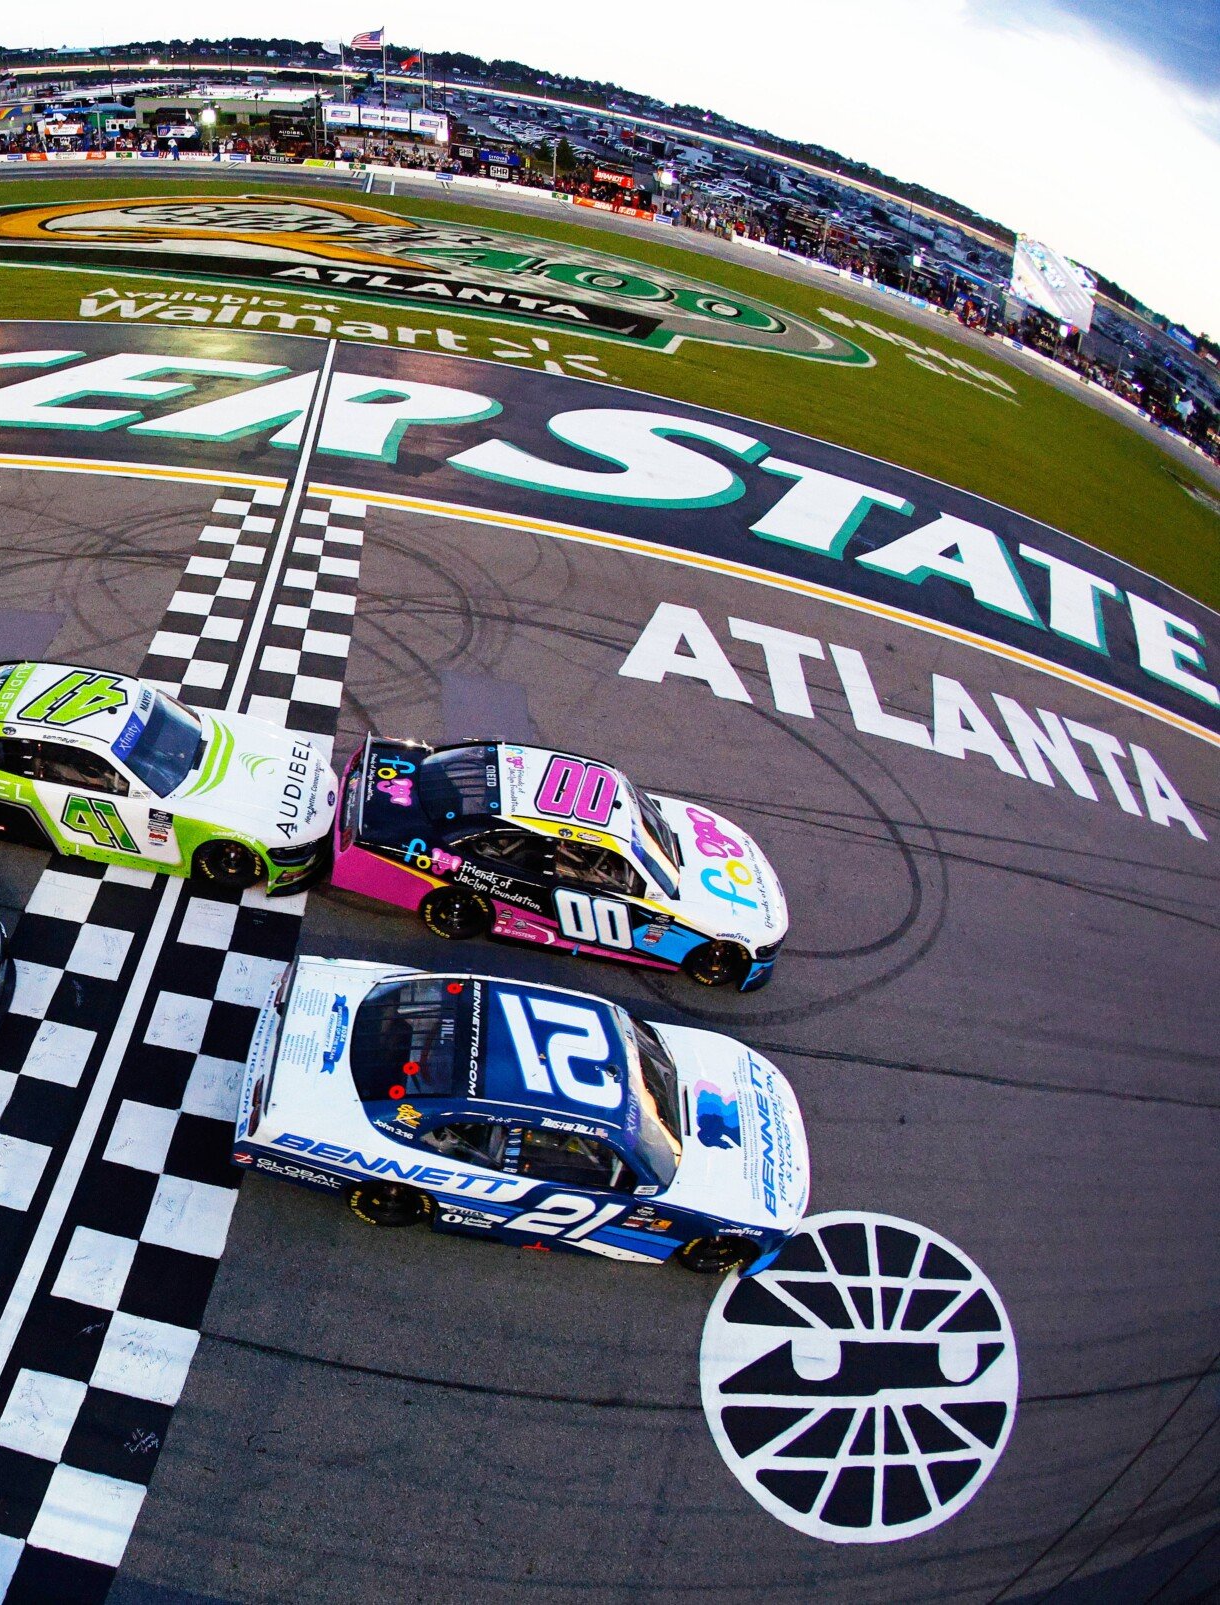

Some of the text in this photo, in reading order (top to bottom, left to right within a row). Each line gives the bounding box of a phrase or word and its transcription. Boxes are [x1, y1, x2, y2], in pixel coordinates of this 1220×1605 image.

[490, 166, 509, 176] SHR
[595, 171, 624, 183] BRANDT
[86, 287, 341, 314] Available at
[271, 266, 590, 320] ATLANTA
[79, 298, 469, 353] Walmart
[447, 408, 1220, 709] STATE
[17, 670, 128, 726] 41
[139, 689, 154, 713] MAYER
[617, 600, 1209, 841] ATLANTA
[118, 721, 142, 751] xfinity
[276, 740, 314, 840] AUDIBEL
[485, 764, 498, 788] CREED
[534, 755, 620, 826] 00
[60, 791, 142, 855] 41
[454, 872, 543, 914] Jaclyn Foundation.
[460, 860, 513, 890] Friends of
[511, 930, 537, 940] SYSTEMS
[552, 887, 633, 951] 00
[716, 931, 752, 944] GOODYEAR
[467, 980, 483, 1097] BENNETTIG.COM
[495, 990, 623, 1109] 21
[372, 1119, 415, 1140] John 3:16
[747, 1051, 777, 1218] BENNETT
[766, 1071, 787, 1202] TRANSPORTATON
[255, 1163, 342, 1189] INDUSTRIAL
[256, 1157, 342, 1186] GLOBAL
[271, 1132, 519, 1195] BENNETT
[502, 1193, 628, 1241] 21
[717, 1226, 764, 1237] GOODYEAR
